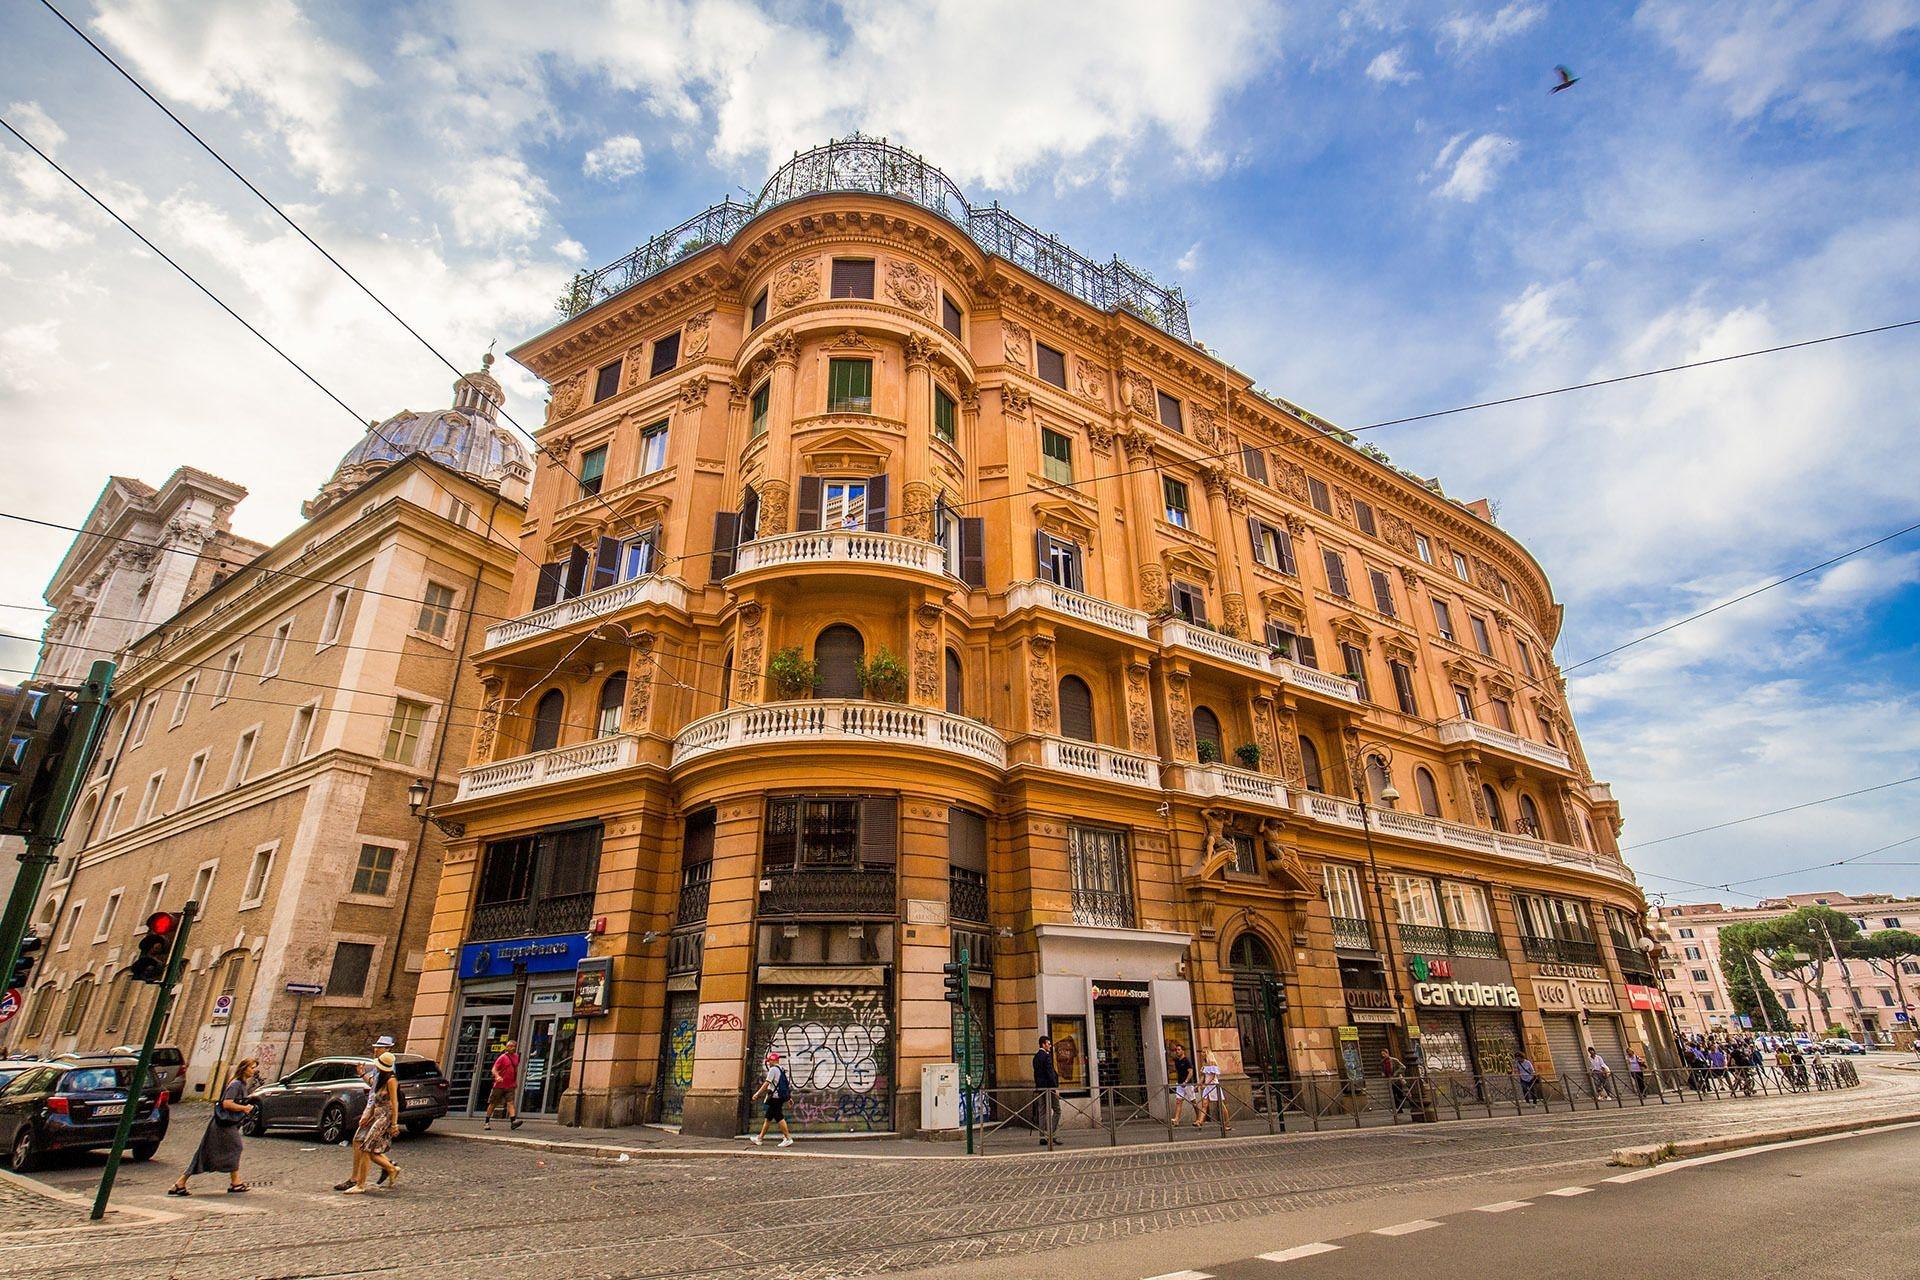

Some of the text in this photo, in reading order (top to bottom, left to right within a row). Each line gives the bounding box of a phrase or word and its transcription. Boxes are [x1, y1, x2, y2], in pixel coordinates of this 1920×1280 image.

[1540, 964, 1600, 979] CALZATURE
[1347, 990, 1390, 1008] OTTICA
[1414, 981, 1521, 1007] cartoleria
[1540, 986, 1564, 1002] UGO
